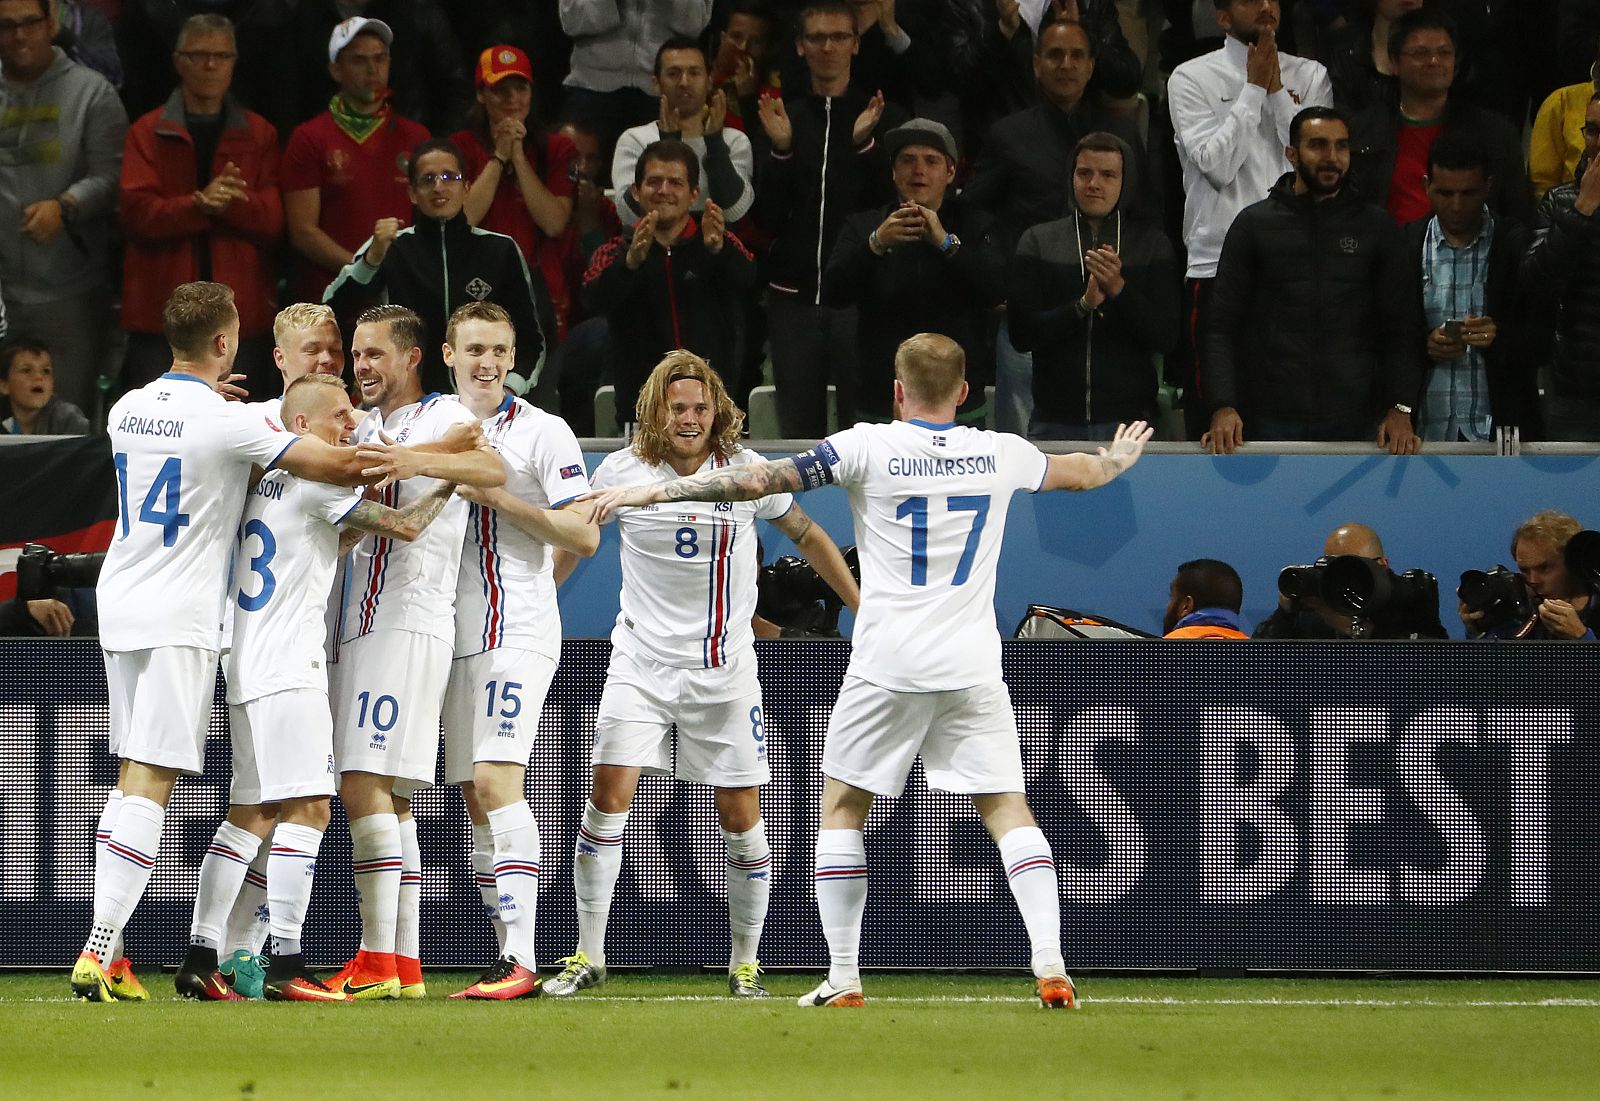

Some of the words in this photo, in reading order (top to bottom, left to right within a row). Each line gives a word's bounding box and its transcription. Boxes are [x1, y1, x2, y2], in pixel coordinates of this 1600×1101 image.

[117, 411, 185, 438] ÁRNASON
[888, 455, 997, 477] GUNNARSSON
[114, 452, 190, 548] 14
[249, 478, 285, 500] SON
[674, 526, 700, 559] 8
[896, 494, 992, 587] 17
[227, 519, 277, 612] 3
[357, 691, 399, 732] 10
[485, 680, 523, 719] 15
[751, 705, 766, 742] 8
[1200, 704, 1575, 907] BEST
